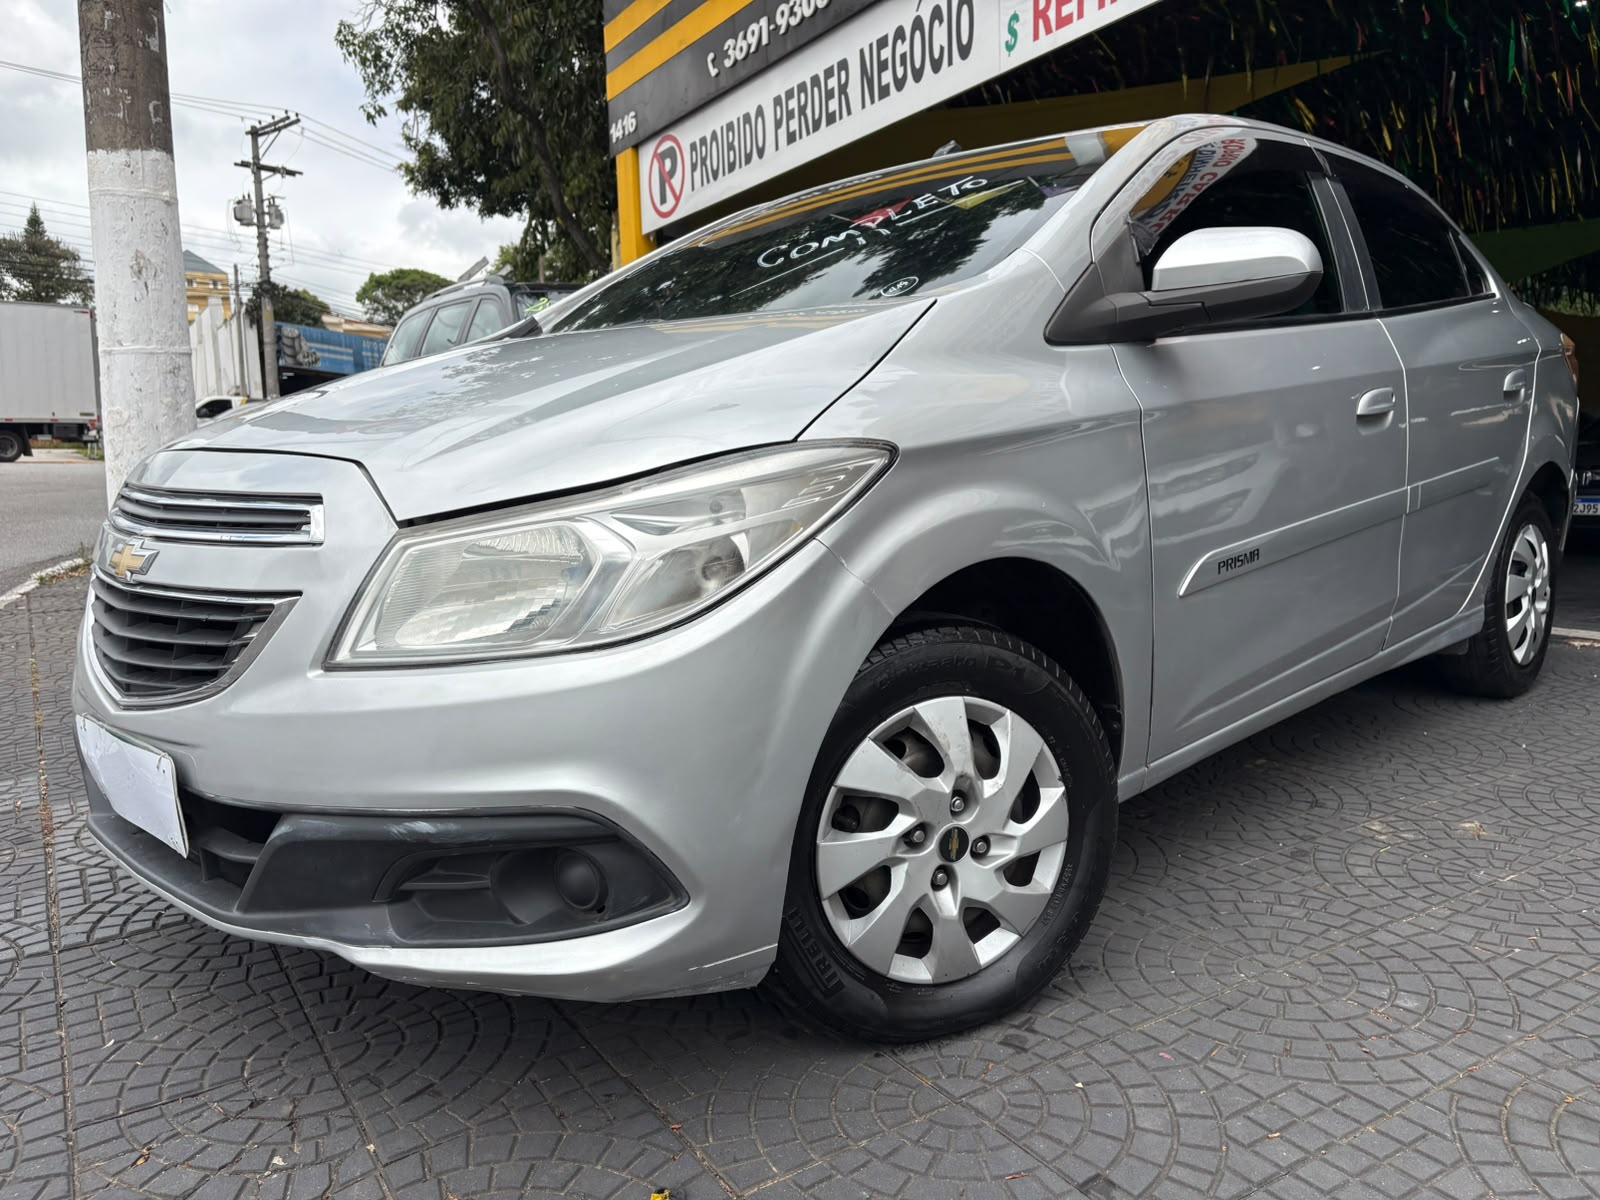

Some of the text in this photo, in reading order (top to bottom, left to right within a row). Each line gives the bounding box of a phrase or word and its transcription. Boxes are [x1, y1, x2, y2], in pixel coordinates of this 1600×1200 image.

[723, 0, 828, 68] 3691-930
[689, 104, 766, 192] PROIBIDO
[773, 57, 852, 152] PERDER
[859, 0, 974, 110] NEGÓCIO
[610, 111, 637, 144] 1416
[1217, 548, 1260, 575] PRISMA
